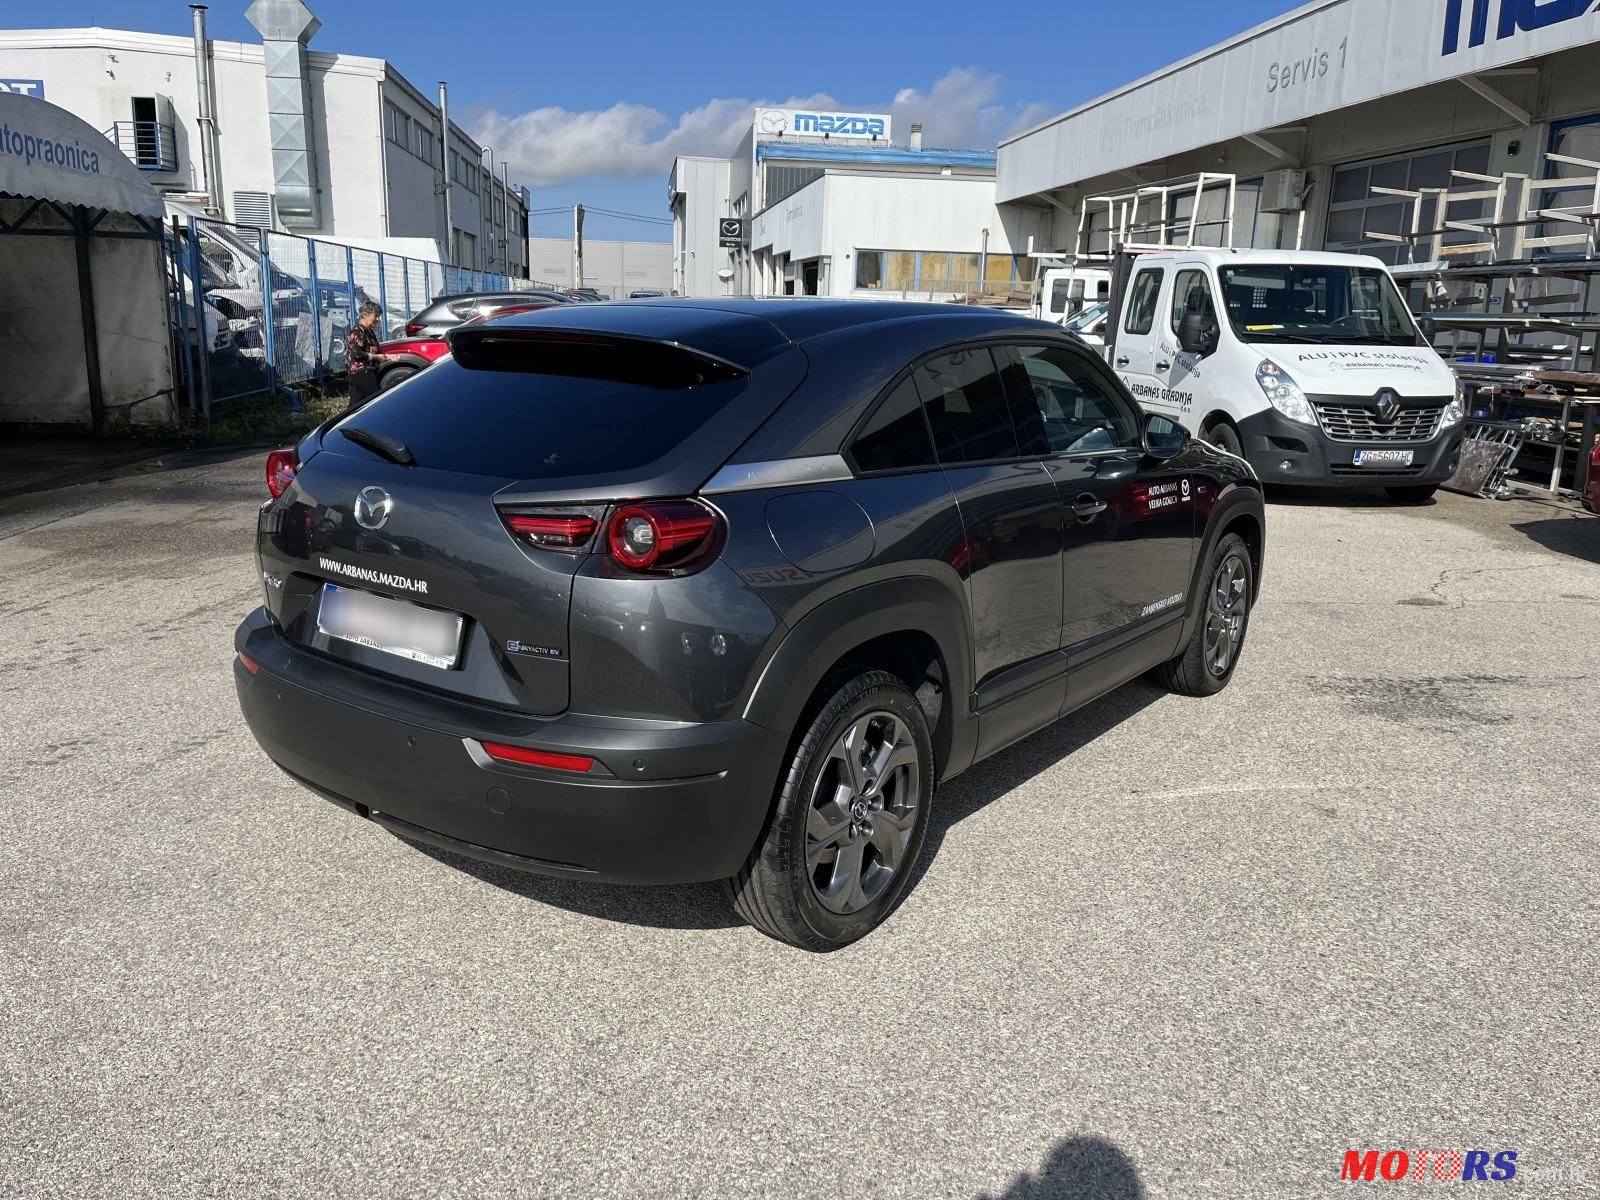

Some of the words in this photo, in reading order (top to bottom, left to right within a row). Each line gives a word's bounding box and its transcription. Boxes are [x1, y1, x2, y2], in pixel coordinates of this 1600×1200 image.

[1267, 47, 1329, 93] Servis
[1339, 35, 1348, 69] 1
[1298, 352, 1328, 362] ALU
[1338, 351, 1371, 359] PVC
[1372, 352, 1430, 365] stolarija
[1131, 383, 1160, 399] ARBANAS
[1161, 388, 1193, 406] GRADNJA
[319, 556, 429, 593] WWW.ARBANAS.MAZDA.HR
